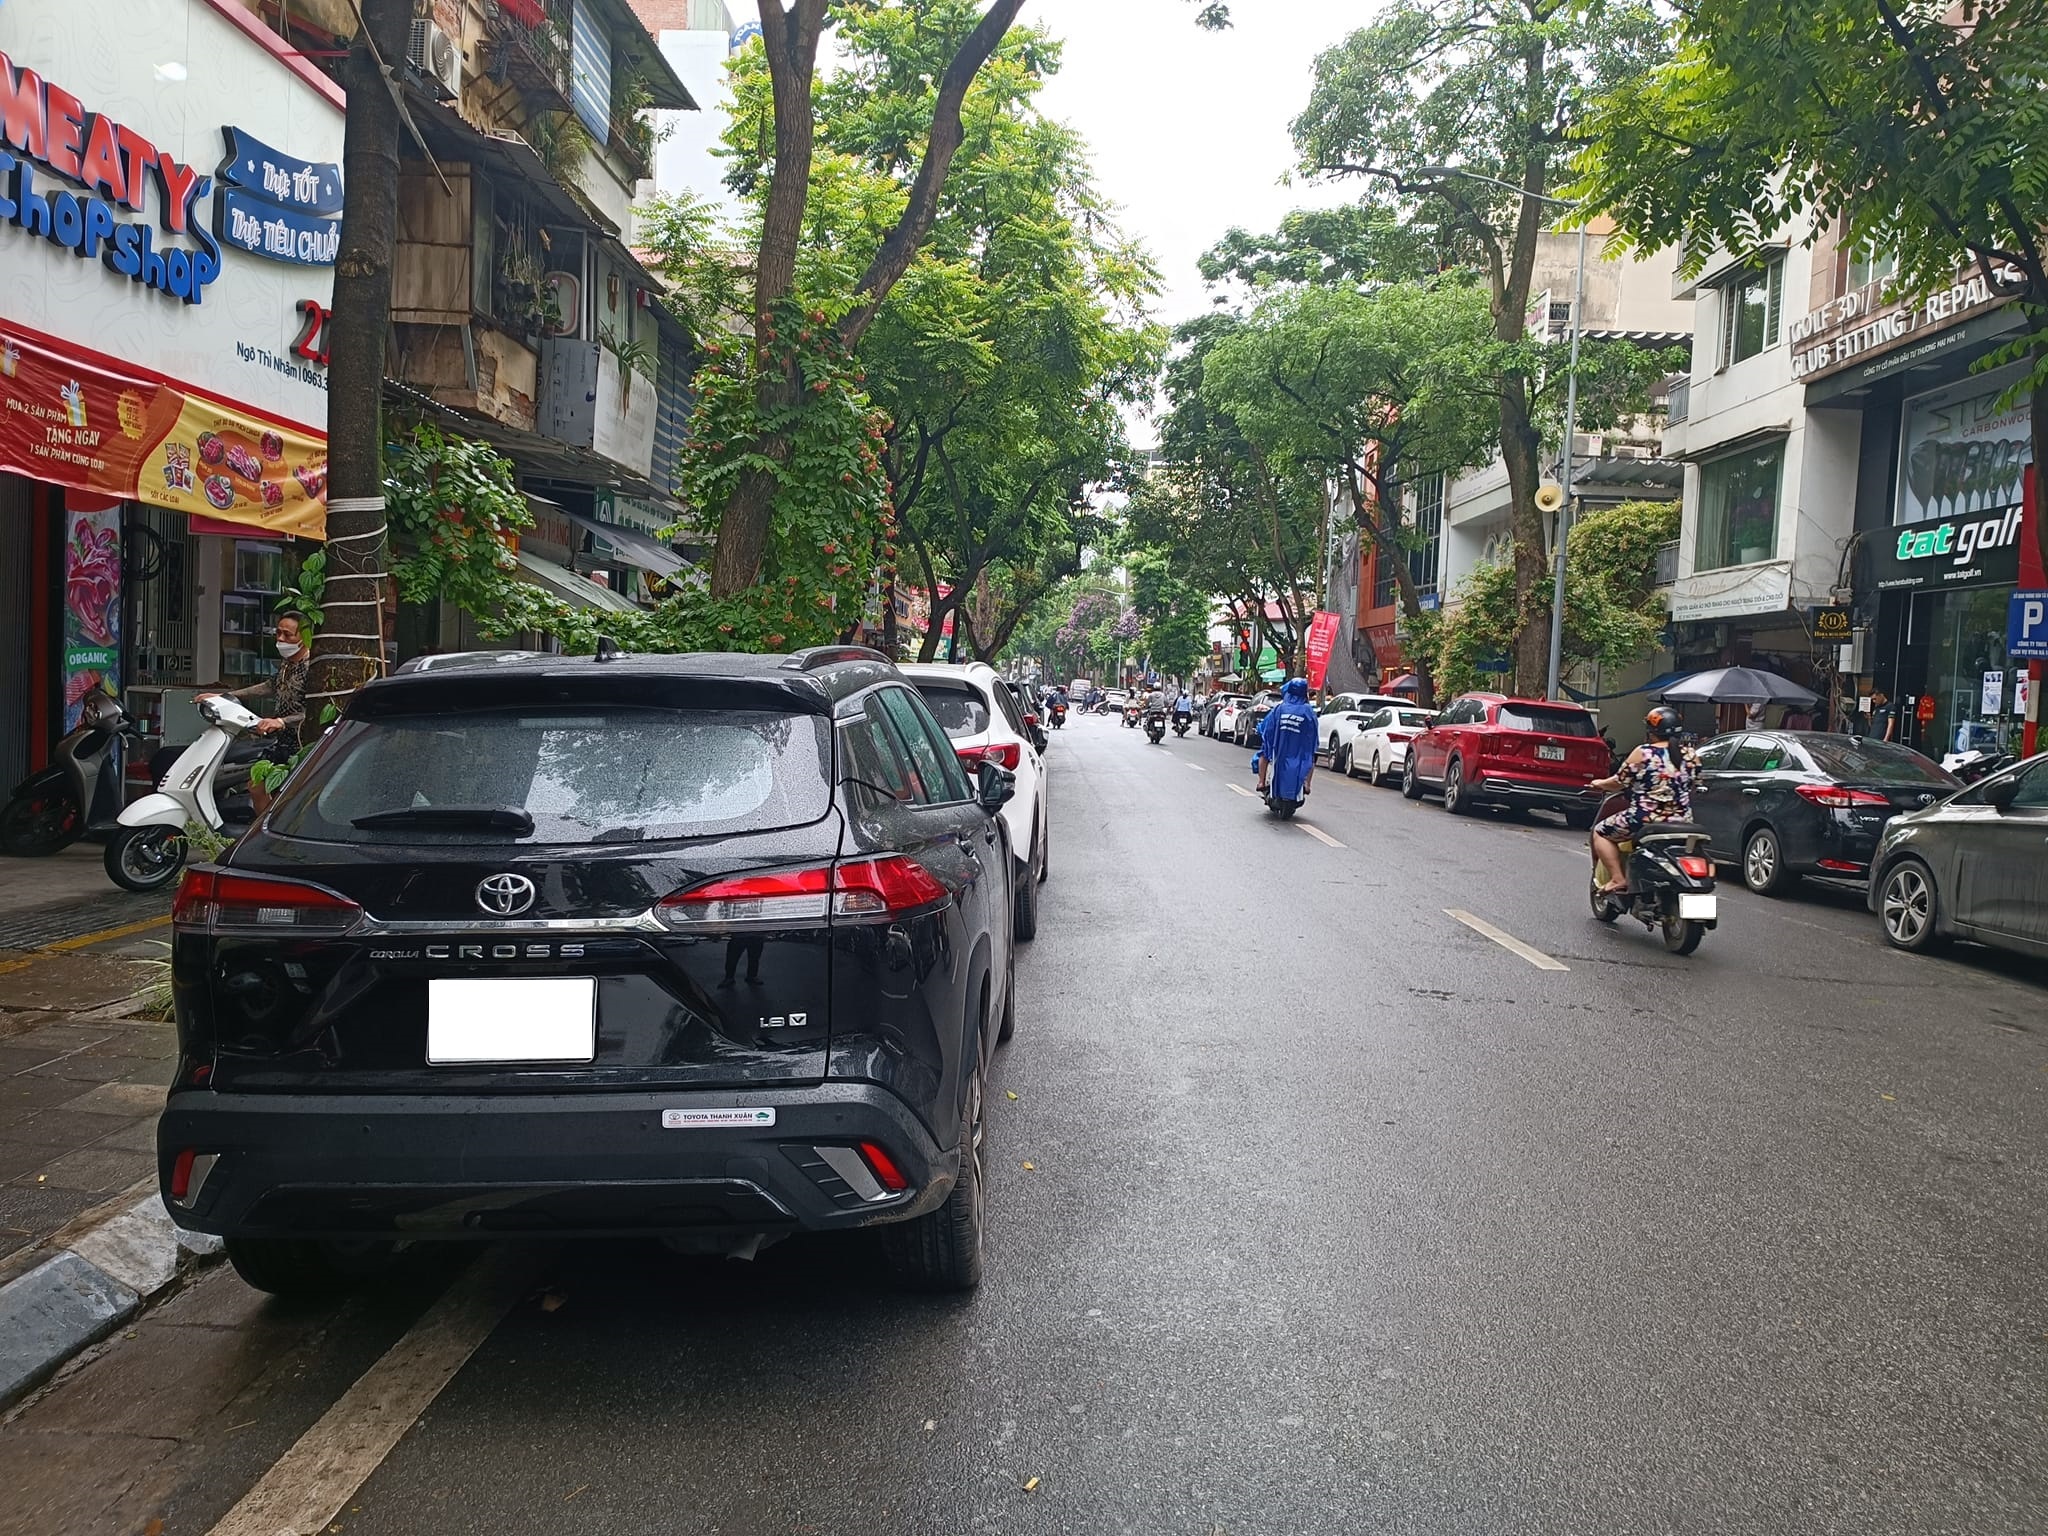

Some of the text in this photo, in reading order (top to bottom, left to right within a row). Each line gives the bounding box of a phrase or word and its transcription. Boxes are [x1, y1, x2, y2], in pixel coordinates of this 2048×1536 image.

[0, 52, 199, 234] MEATY
[293, 165, 320, 204] TỐT
[263, 218, 297, 258] TIÊU
[1790, 302, 1834, 342] GOLF
[1836, 290, 1862, 322] 3D
[236, 341, 256, 362] Ngô
[257, 349, 273, 369] Thì
[273, 356, 298, 378] Nhậm
[1791, 343, 1832, 380] CLUB
[1835, 309, 1907, 363] FITTING
[6, 398, 23, 412] MUA
[24, 403, 29, 414] 2
[45, 425, 101, 447] TẶNG NGAY
[1897, 506, 2024, 566] tat golf
[2022, 601, 2044, 639] P
[69, 652, 108, 665] ORGANIC
[425, 944, 585, 959] CROSS
[710, 1112, 732, 1120] THANH
[734, 1111, 753, 1119] XUÂN
